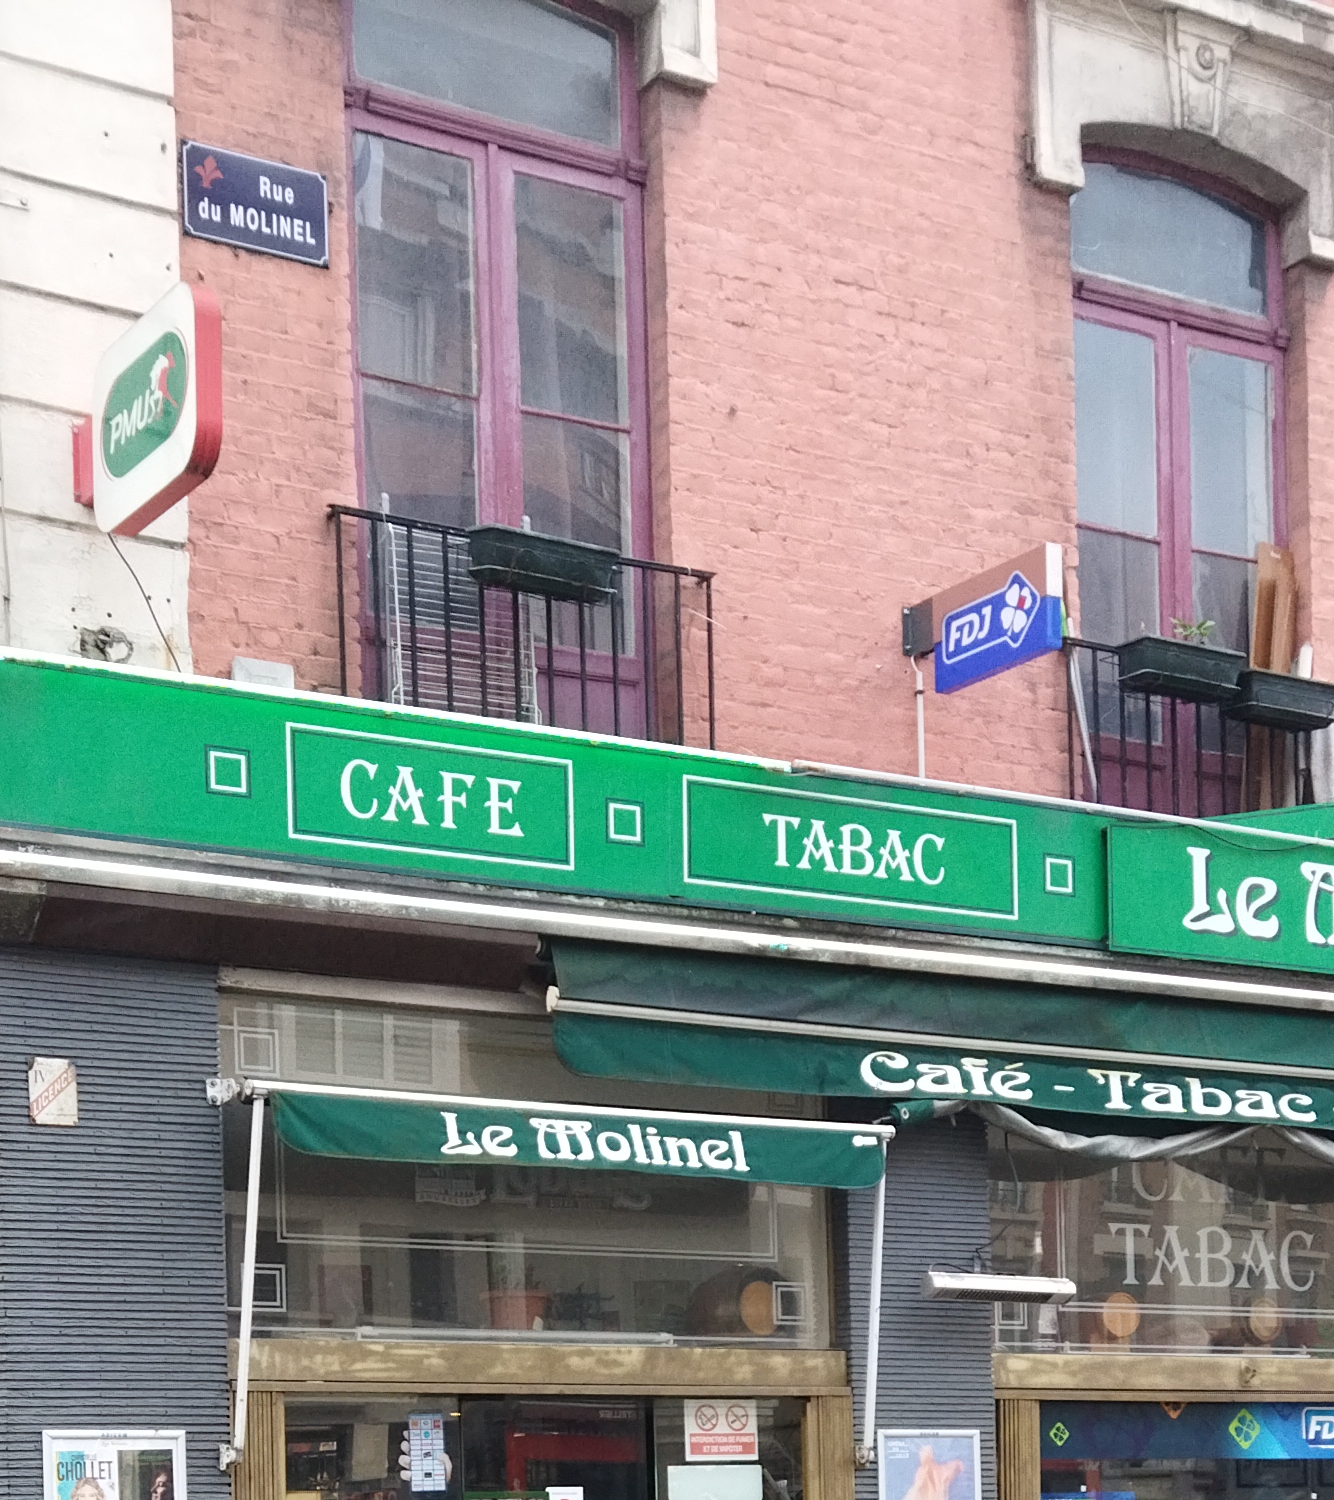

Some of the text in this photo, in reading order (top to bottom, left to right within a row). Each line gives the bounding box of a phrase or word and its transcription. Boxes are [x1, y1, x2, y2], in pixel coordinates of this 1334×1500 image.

[198, 200, 316, 244] du MOLINEL
[259, 175, 295, 205] Rue
[109, 388, 151, 455] PMU
[948, 604, 991, 653] FDJ
[339, 757, 525, 839] CAFE
[762, 811, 947, 887] TABAC
[1181, 846, 1280, 939] Le
[32, 1068, 73, 1116] LICENCE
[860, 1050, 1033, 1101] Café
[1087, 1068, 1317, 1124] Tabac
[439, 1111, 750, 1173] Le Molinel
[1107, 1221, 1315, 1292] TABAC
[56, 1460, 113, 1481] CHOLLET
